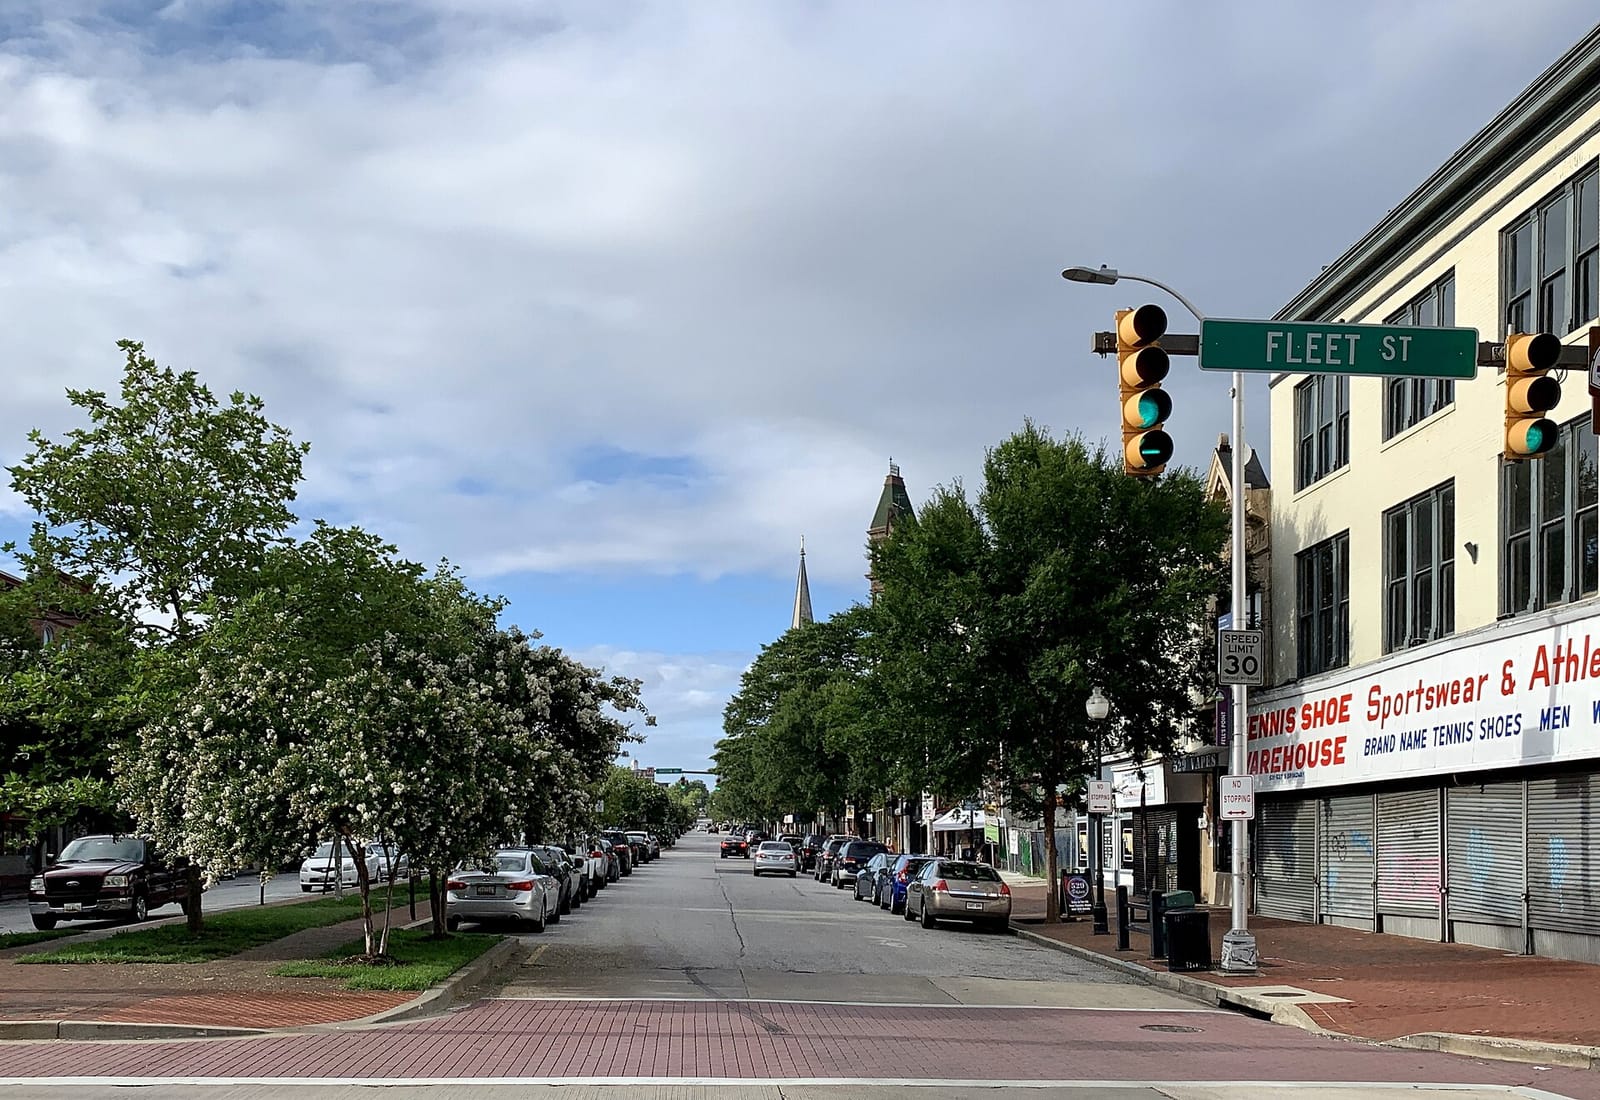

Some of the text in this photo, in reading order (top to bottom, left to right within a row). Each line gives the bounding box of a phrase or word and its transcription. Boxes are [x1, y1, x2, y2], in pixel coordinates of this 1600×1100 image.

[1266, 331, 1412, 365] FLEET ST
[1223, 634, 1260, 644] SPEED
[1228, 644, 1254, 654] LIMIT
[1223, 655, 1259, 676] 30
[1366, 673, 1489, 730] Sportswear
[1500, 659, 1516, 696] &
[1247, 693, 1353, 741] ENNIS SHOE
[1363, 734, 1396, 756] BRAND
[1399, 728, 1428, 752] NAME
[1432, 720, 1474, 747] TENNIS
[1479, 712, 1522, 741] SHOES
[1538, 704, 1571, 732] MEN
[1172, 753, 1216, 773] 529 VAPES
[1232, 780, 1242, 788] NO
[1223, 795, 1251, 803] STOPPING
